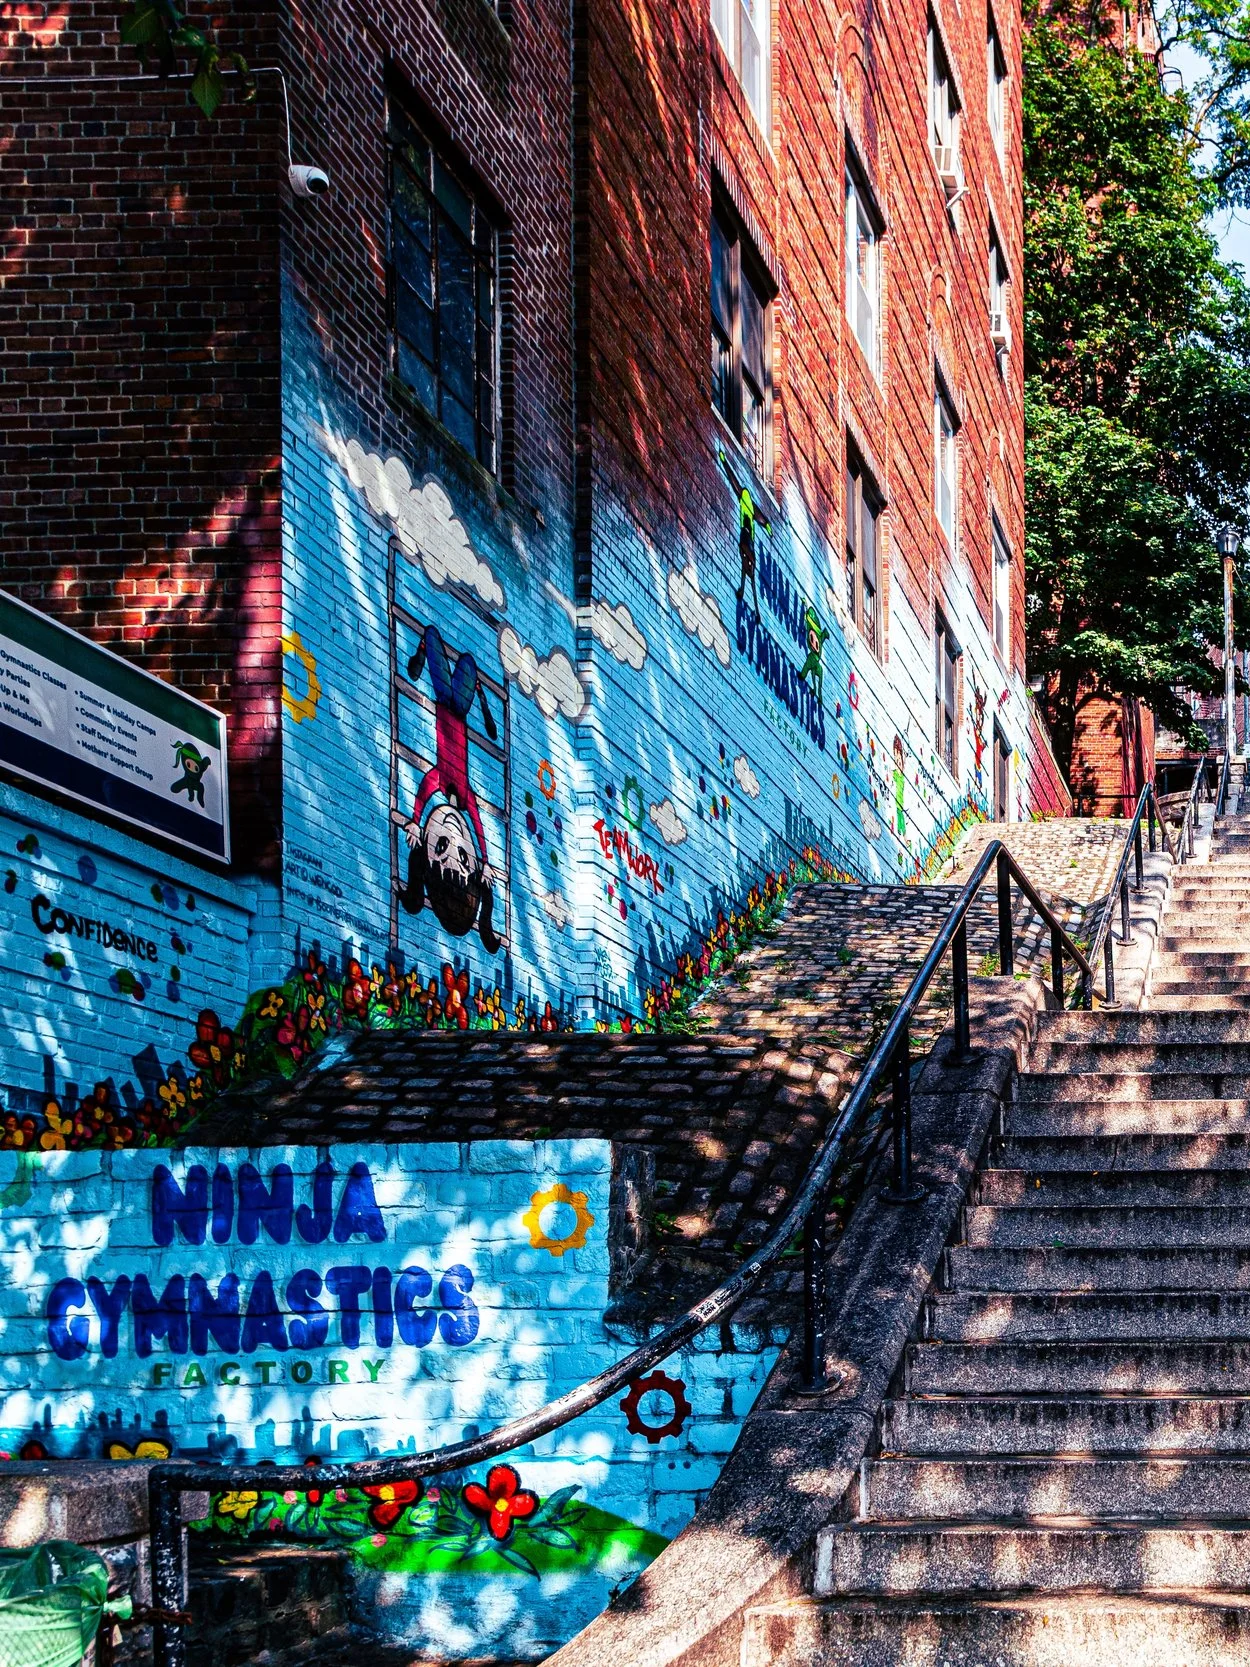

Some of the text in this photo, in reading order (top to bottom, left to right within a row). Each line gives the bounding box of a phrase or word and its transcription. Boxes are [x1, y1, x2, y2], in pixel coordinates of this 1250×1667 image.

[0, 649, 41, 677] Gymnastics
[2, 702, 42, 727] Workshops
[79, 690, 105, 709] Summer
[112, 708, 136, 727] Holiday
[136, 720, 157, 736] Camps
[80, 707, 138, 742] Community Events
[80, 723, 138, 758] Staff Development
[110, 753, 135, 772] Support
[135, 765, 154, 781] Group
[592, 818, 665, 895] TEAMWORK
[151, 1161, 387, 1246] NINJA
[46, 1263, 482, 1361] GYMNASTICS
[152, 1358, 386, 1386] FACTORY
